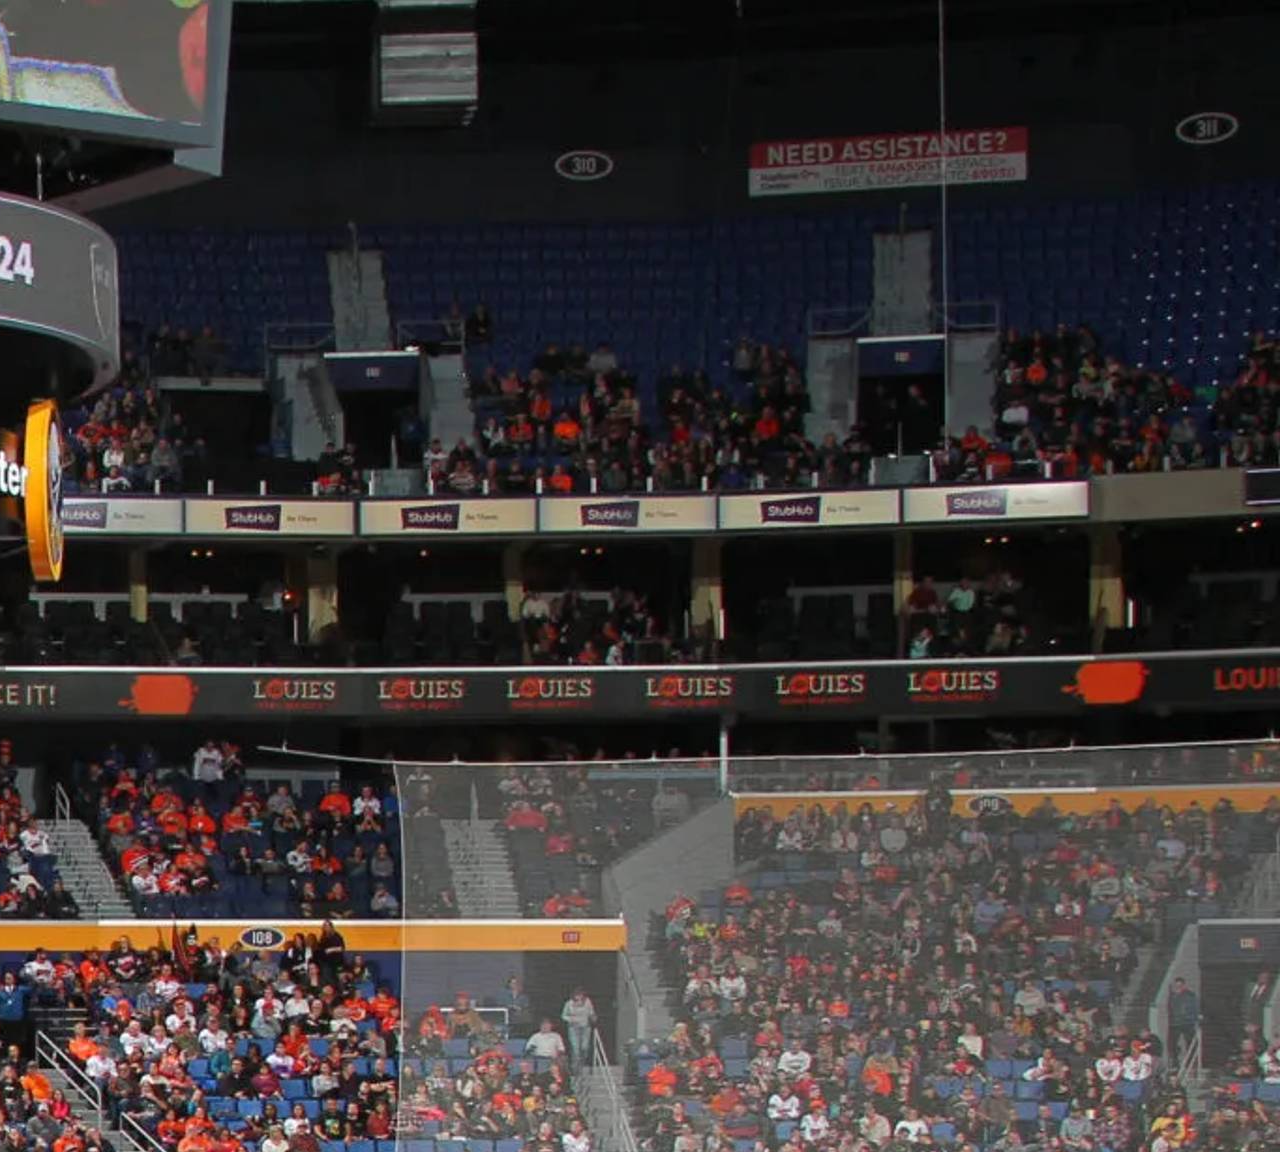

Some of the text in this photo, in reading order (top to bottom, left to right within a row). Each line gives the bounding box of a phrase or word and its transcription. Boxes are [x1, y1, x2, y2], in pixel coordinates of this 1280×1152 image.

[1196, 120, 1218, 137] 311
[767, 132, 1007, 165] NEED ASSISTANCE?
[572, 157, 596, 172] 310
[25, 684, 56, 705] IT!
[252, 931, 273, 945] 108
